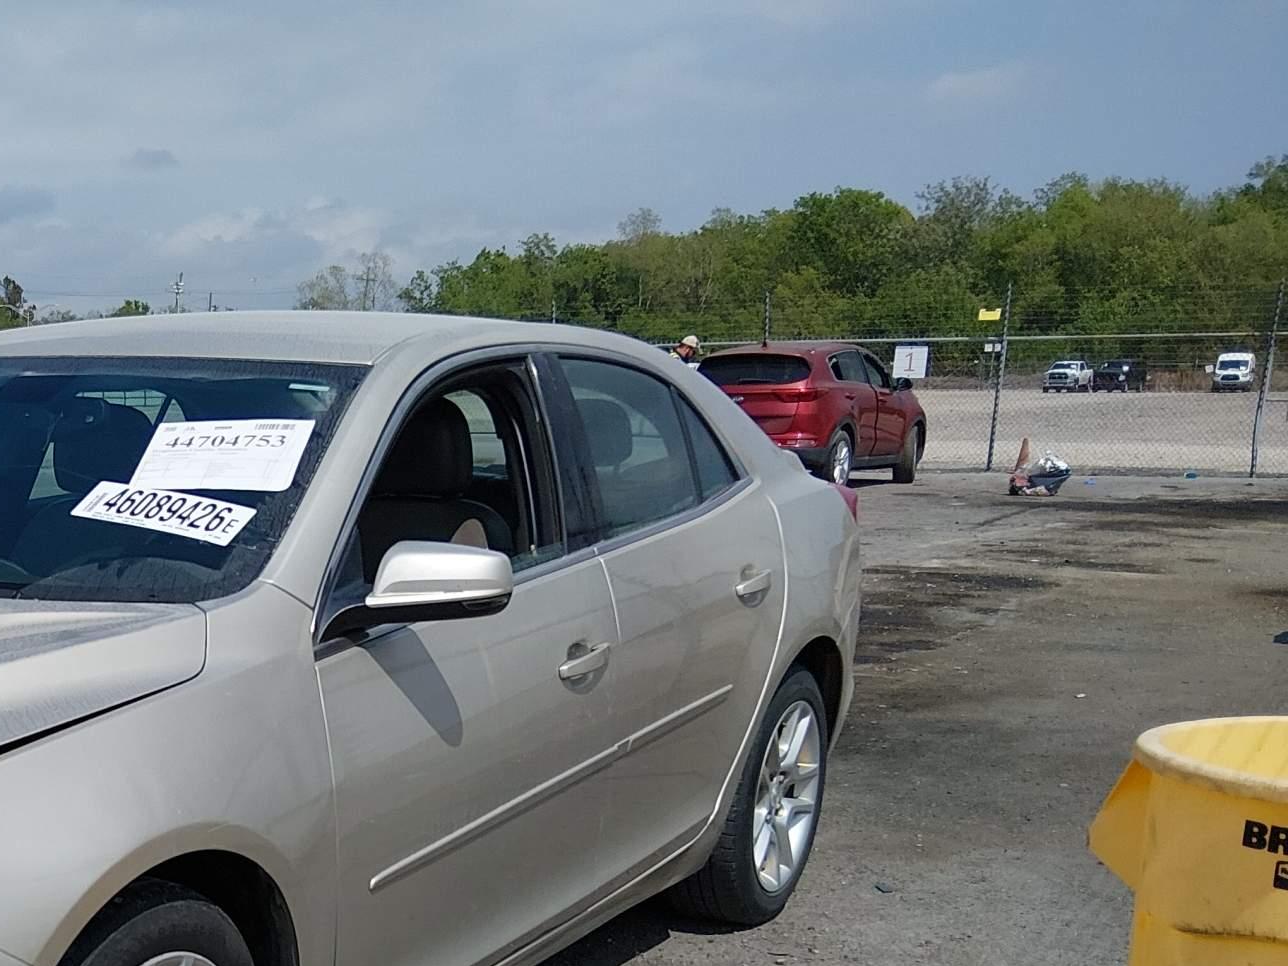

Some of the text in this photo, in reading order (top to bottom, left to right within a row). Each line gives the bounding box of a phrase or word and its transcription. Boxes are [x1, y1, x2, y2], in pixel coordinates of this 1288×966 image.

[903, 352, 916, 372] 1
[165, 434, 287, 448] 44704753
[103, 488, 233, 532] 46089426
[222, 518, 240, 534] E
